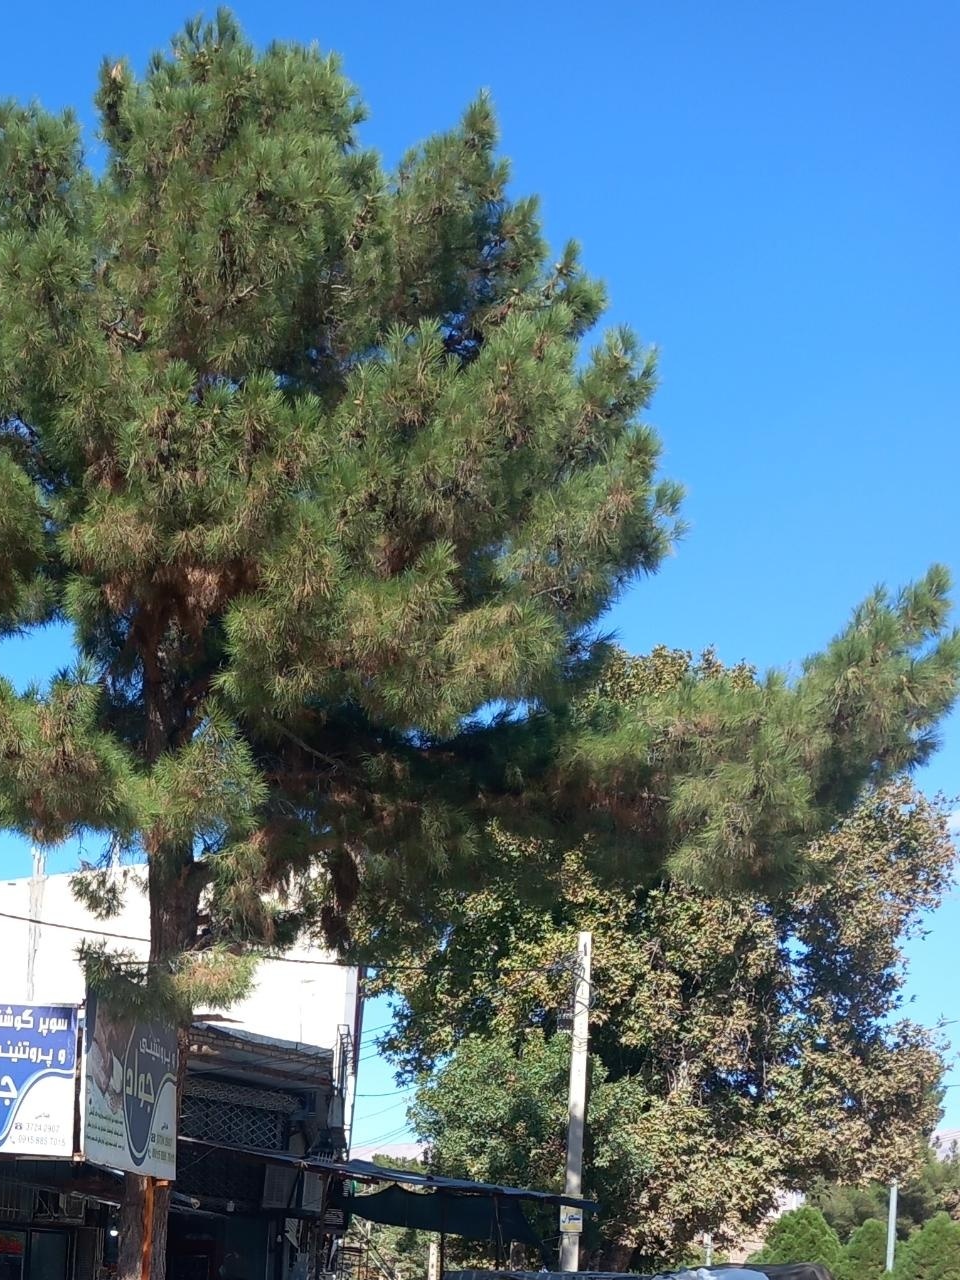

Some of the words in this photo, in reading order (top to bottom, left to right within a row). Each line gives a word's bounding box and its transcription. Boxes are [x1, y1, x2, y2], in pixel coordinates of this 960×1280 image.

[38, 1016, 68, 1036] سوپر
[58, 1049, 66, 1064] و
[126, 1049, 156, 1113] جواد
